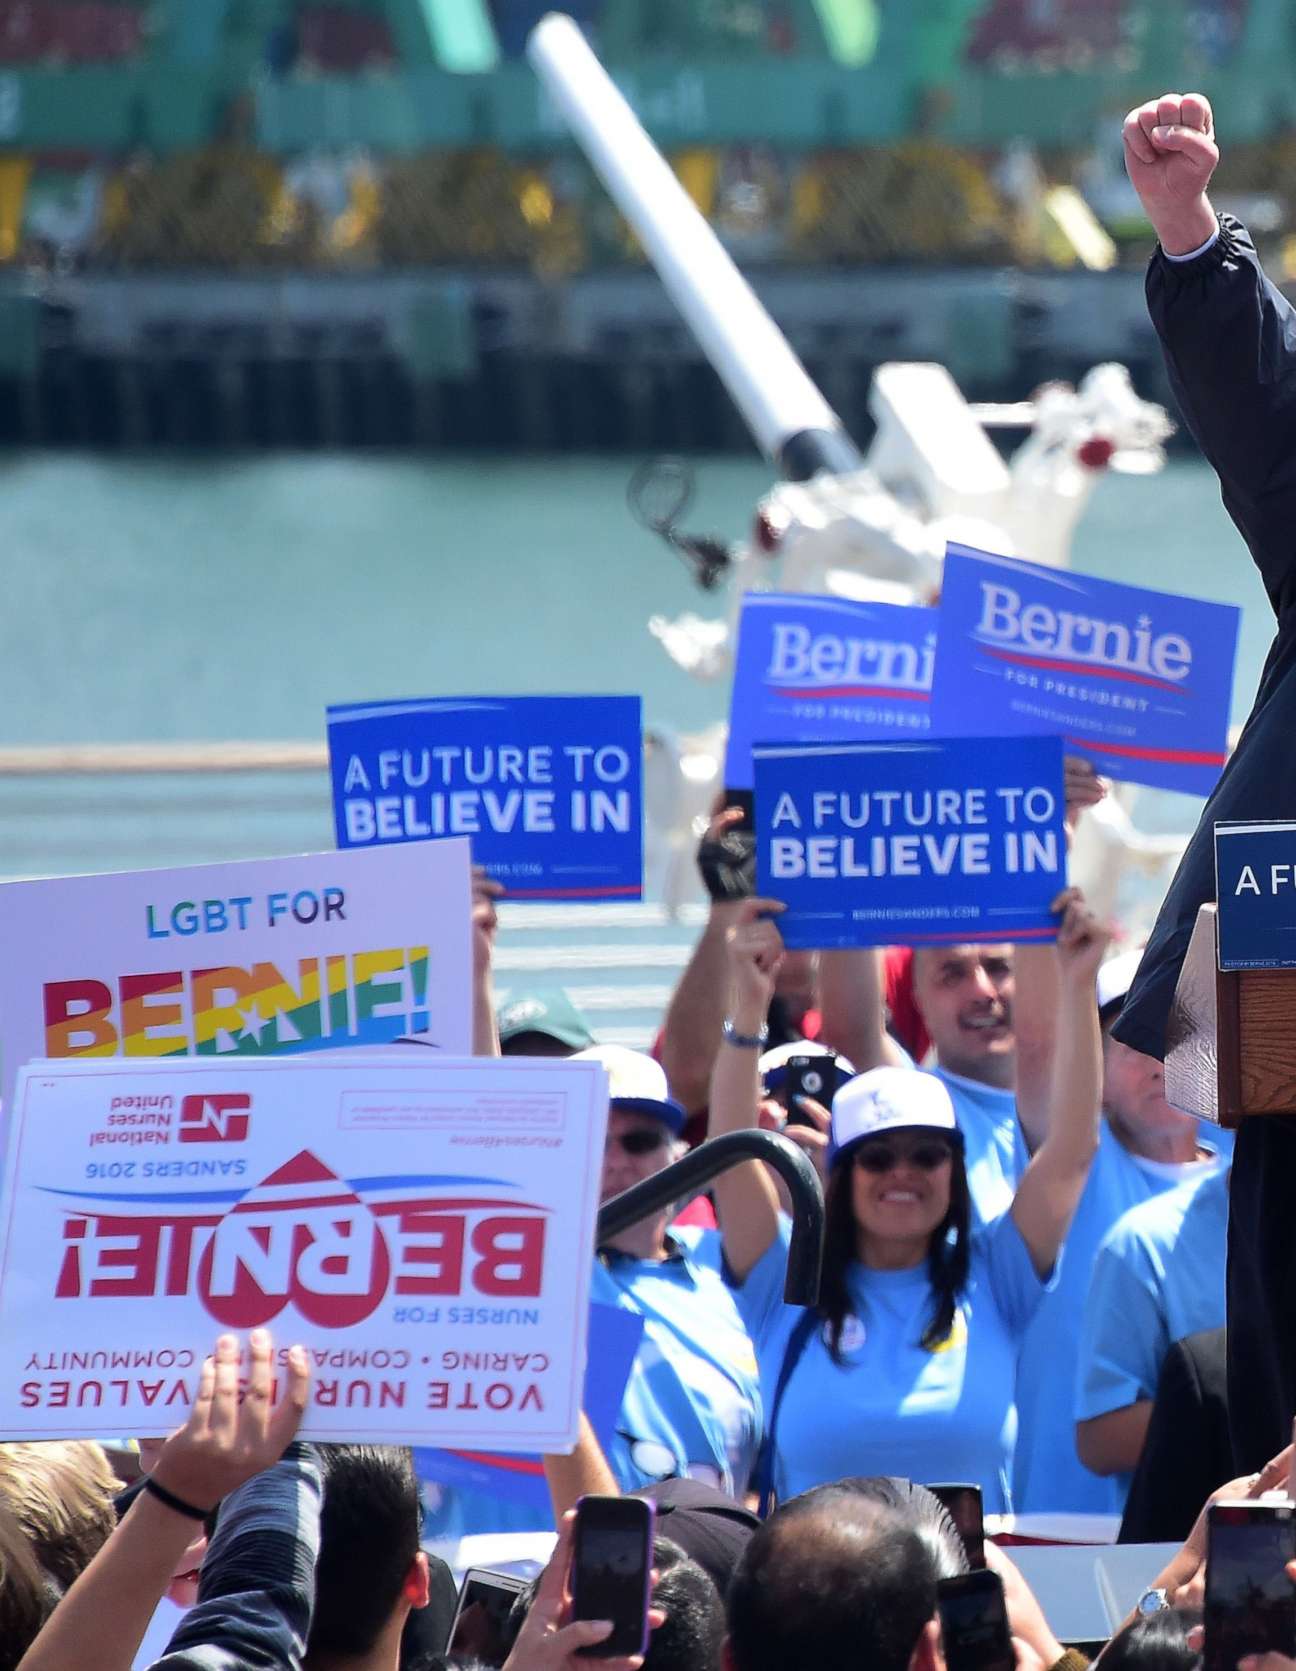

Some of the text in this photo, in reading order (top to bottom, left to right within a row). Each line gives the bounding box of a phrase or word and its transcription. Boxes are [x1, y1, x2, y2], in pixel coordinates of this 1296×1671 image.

[977, 580, 1192, 681] Bernie
[769, 622, 936, 689] Berni
[1003, 669, 1150, 713] FOR PRESIDENT
[344, 747, 630, 792] A FUTURE TO
[346, 789, 630, 841] BELIEVE IN
[772, 786, 1054, 829] A FUTURE TO
[770, 829, 1058, 879] BELIEVE IN
[1235, 866, 1260, 895] A
[146, 888, 347, 939] LGBT FOR
[43, 946, 431, 1058] BERNIE!
[107, 1113, 172, 1128] Nurses
[111, 1095, 174, 1112] United
[89, 1131, 171, 1147] National
[85, 1160, 247, 1179] SANDERS 2016
[56, 1210, 547, 1298] BERNIE!
[393, 1306, 540, 1326] NURSES FOR
[25, 1349, 194, 1371] COMMUNITY
[443, 1350, 549, 1373] CARING
[19, 1379, 191, 1408] VALUES
[427, 1382, 546, 1412] VOTE
